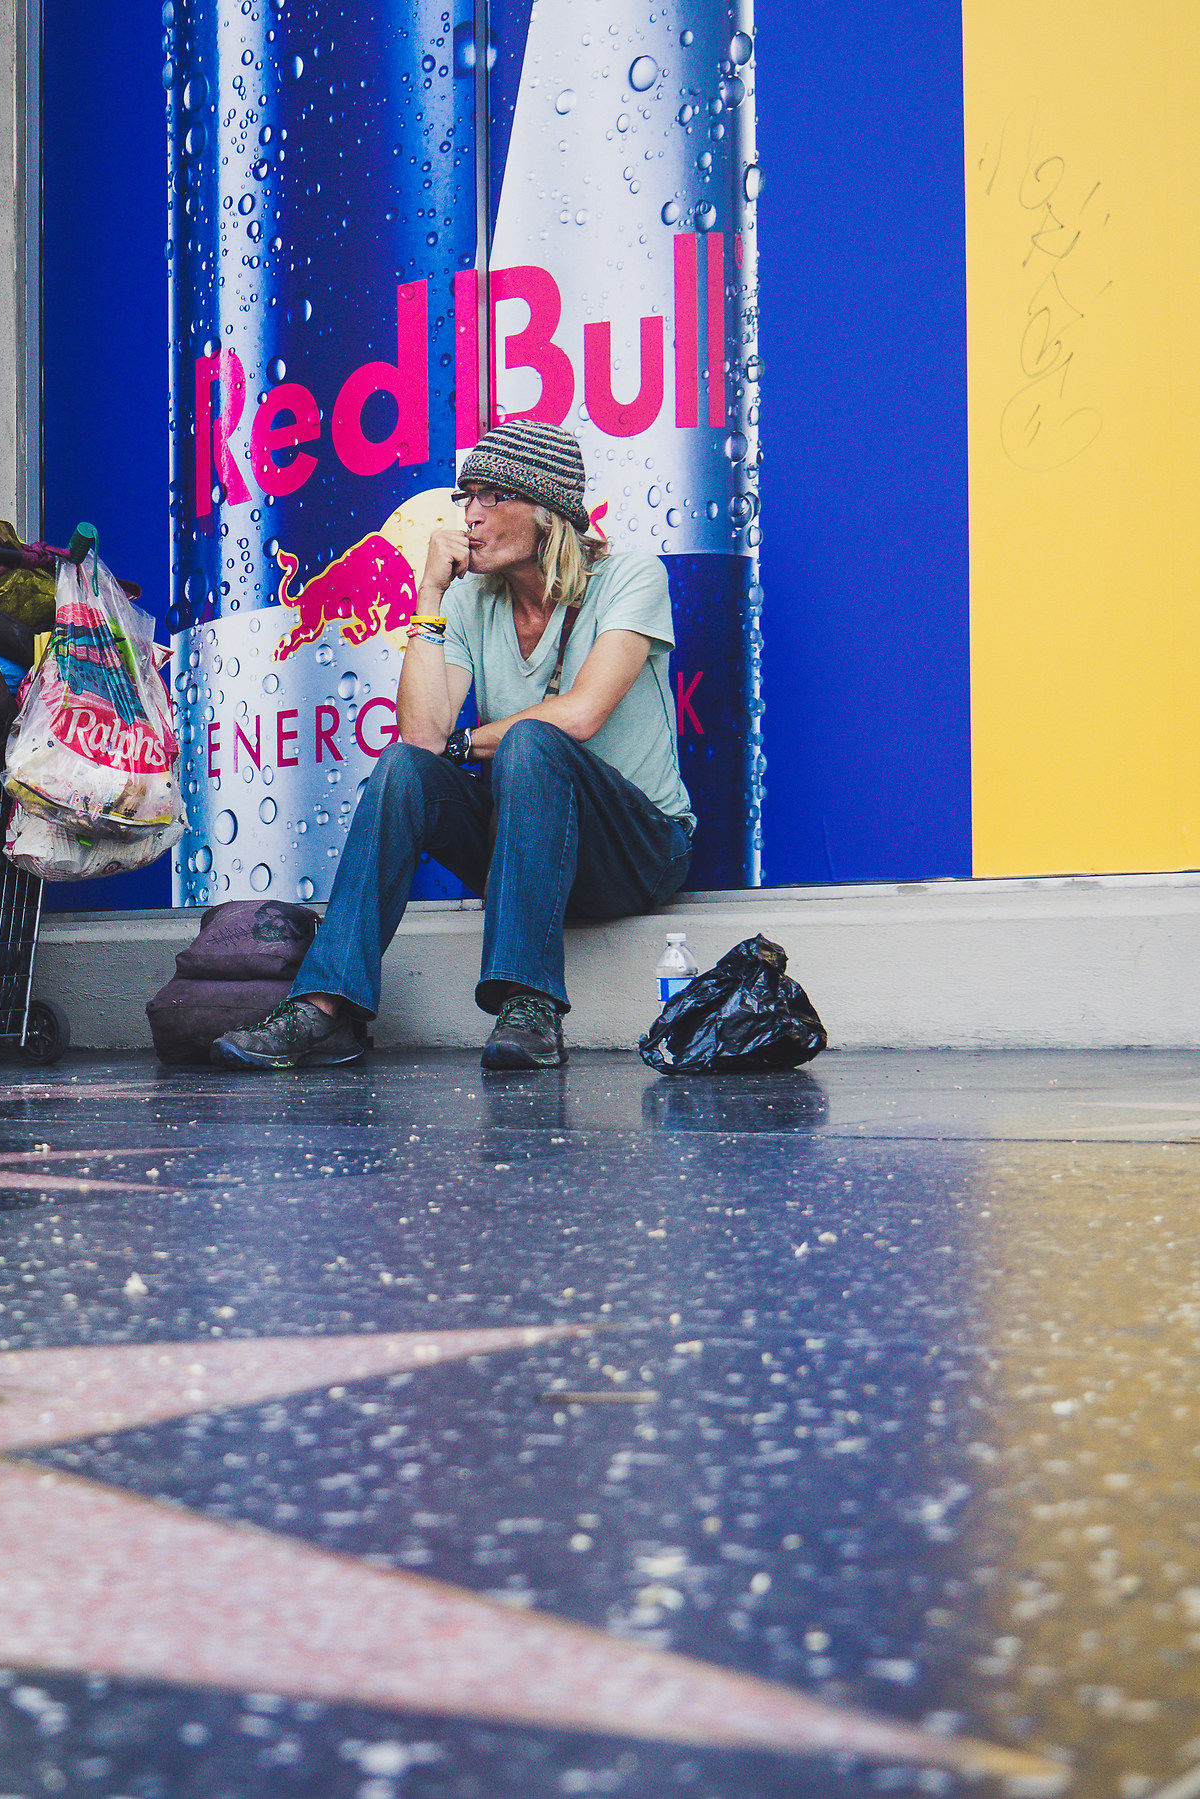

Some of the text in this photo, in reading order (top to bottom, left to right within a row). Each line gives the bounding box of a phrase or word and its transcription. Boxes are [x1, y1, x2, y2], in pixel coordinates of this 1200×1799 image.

[194, 278, 430, 518] Red
[454, 231, 726, 450] Bull
[63, 707, 166, 767] Ralphs
[207, 696, 401, 779] ENERG
